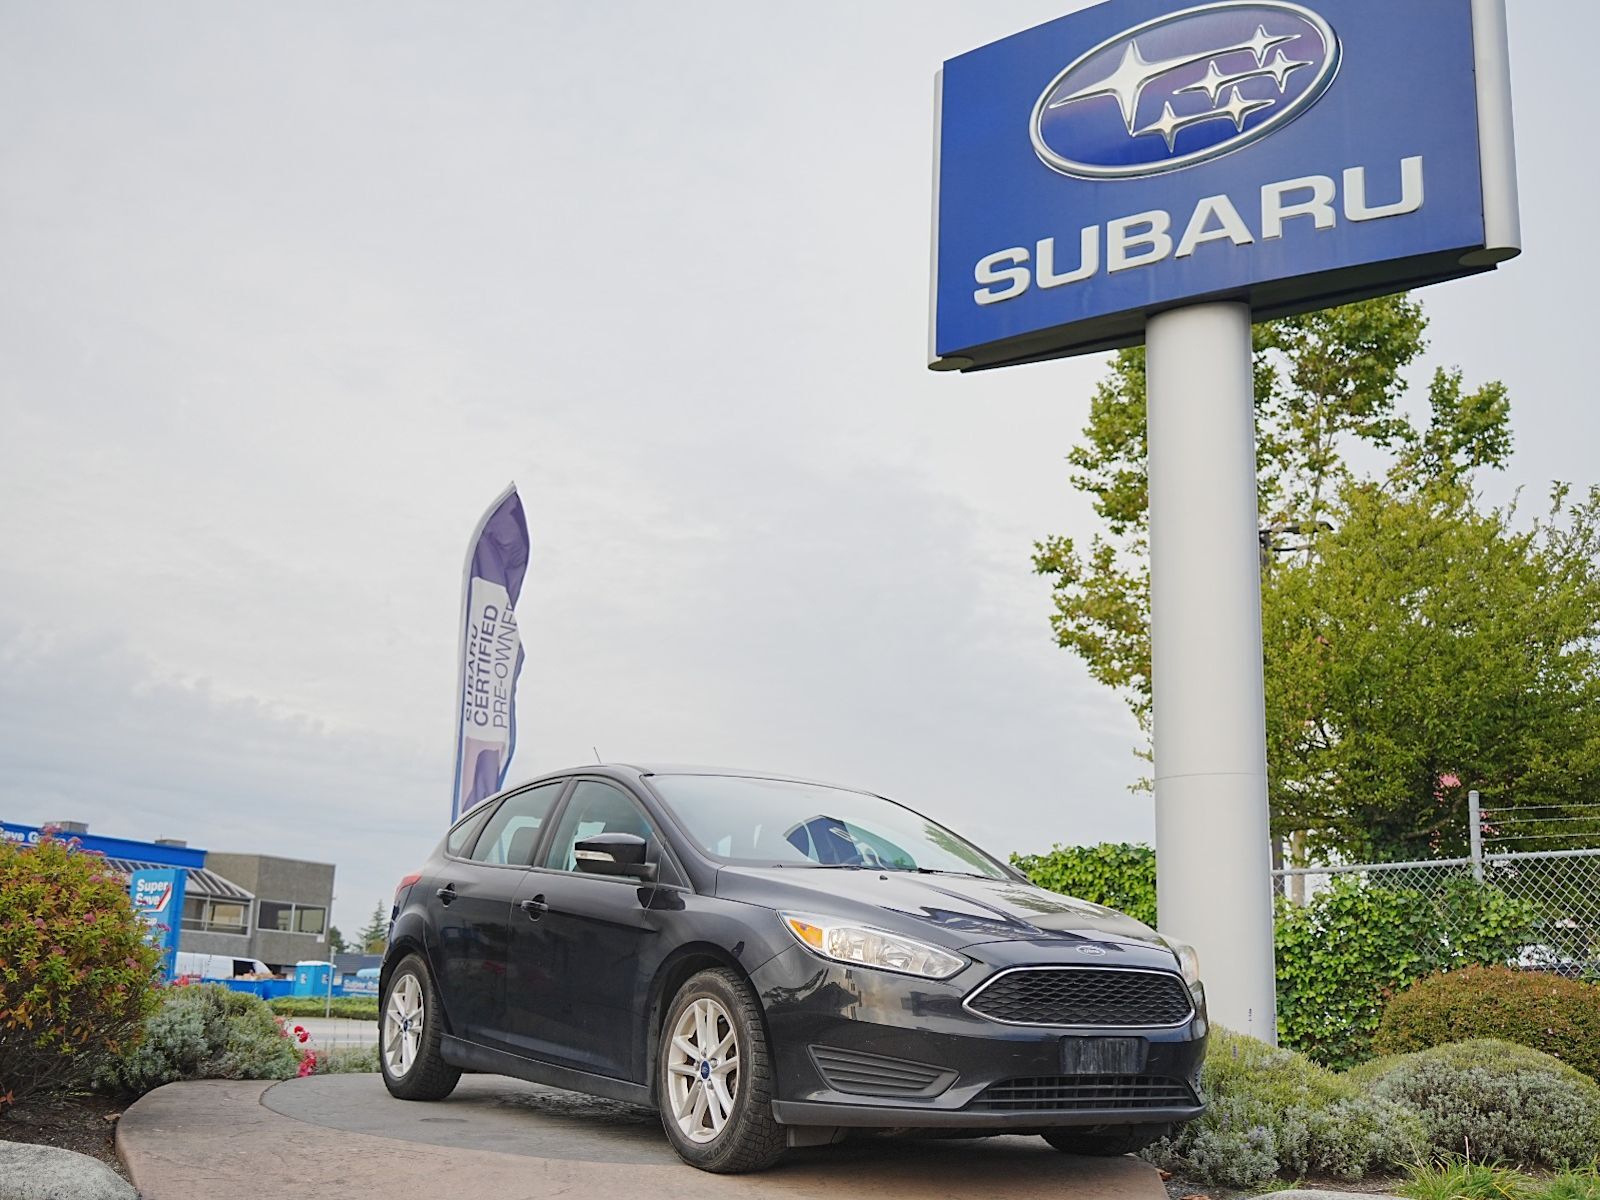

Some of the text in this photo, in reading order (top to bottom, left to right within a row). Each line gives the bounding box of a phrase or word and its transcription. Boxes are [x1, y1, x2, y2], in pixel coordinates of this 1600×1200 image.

[973, 155, 1424, 306] SUBARU
[474, 604, 498, 726] CERTIFIED
[135, 893, 160, 906] Save
[136, 878, 168, 894] Super
